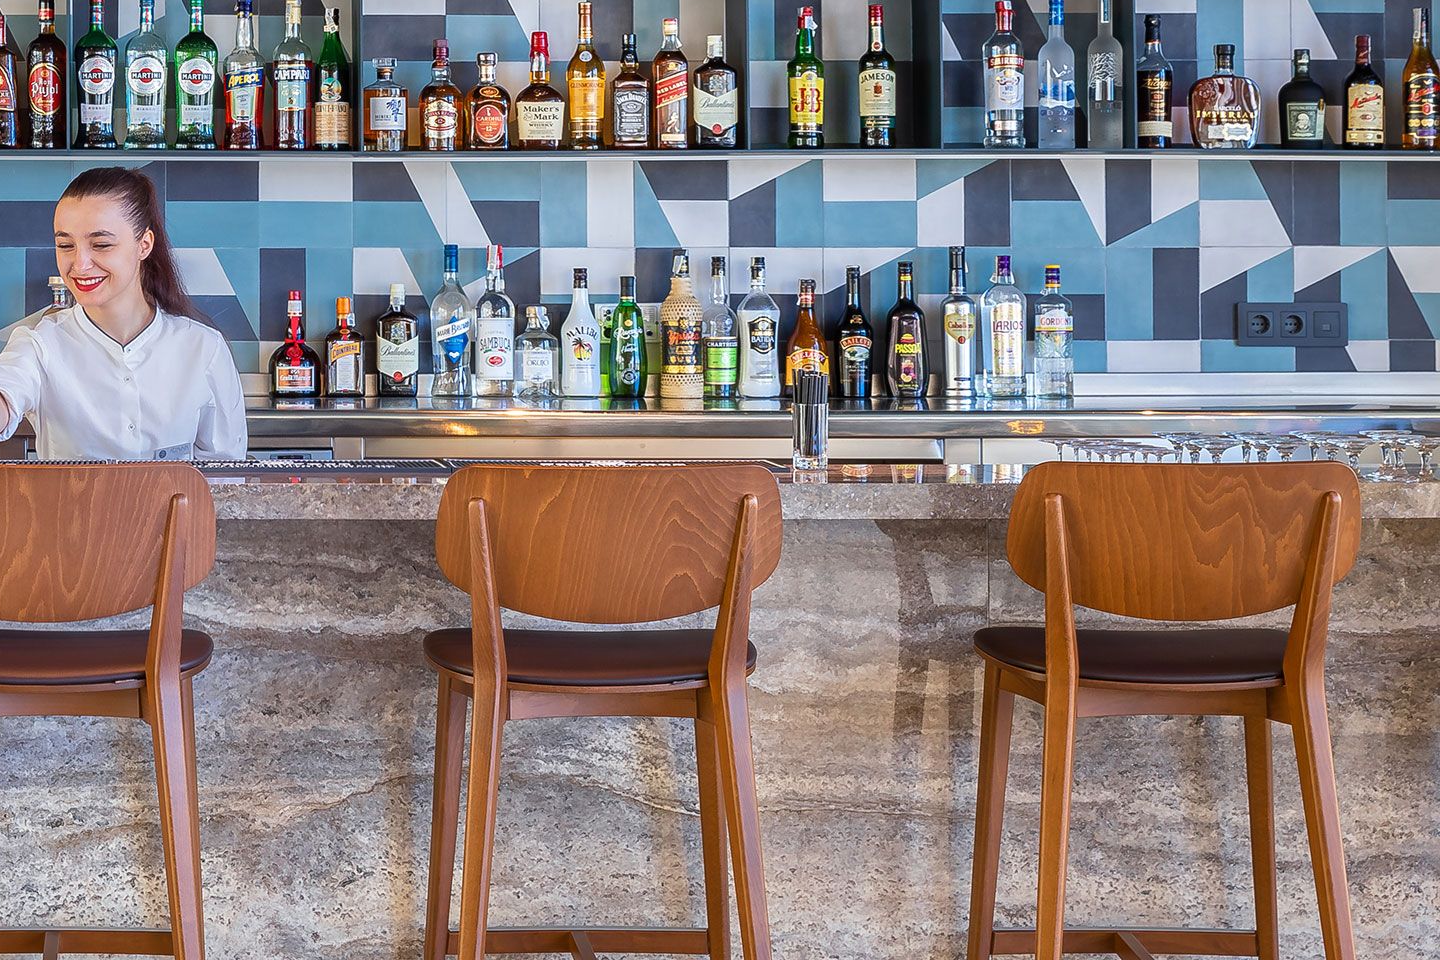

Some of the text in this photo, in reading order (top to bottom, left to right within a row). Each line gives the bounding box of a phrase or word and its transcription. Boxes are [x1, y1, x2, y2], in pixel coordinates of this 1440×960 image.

[274, 68, 310, 80] CAMPARI
[860, 73, 894, 84] JAMESON
[228, 74, 259, 87] APEROL
[31, 83, 59, 98] Pujol
[657, 81, 687, 95] RED LABEL
[533, 112, 560, 121] Mark
[1196, 110, 1256, 119] IMPERIAL
[992, 320, 1025, 332] LARIOS
[566, 326, 600, 340] MALIBU
[480, 338, 511, 351] SAMBUCA
[841, 336, 871, 346] BAILEYS
